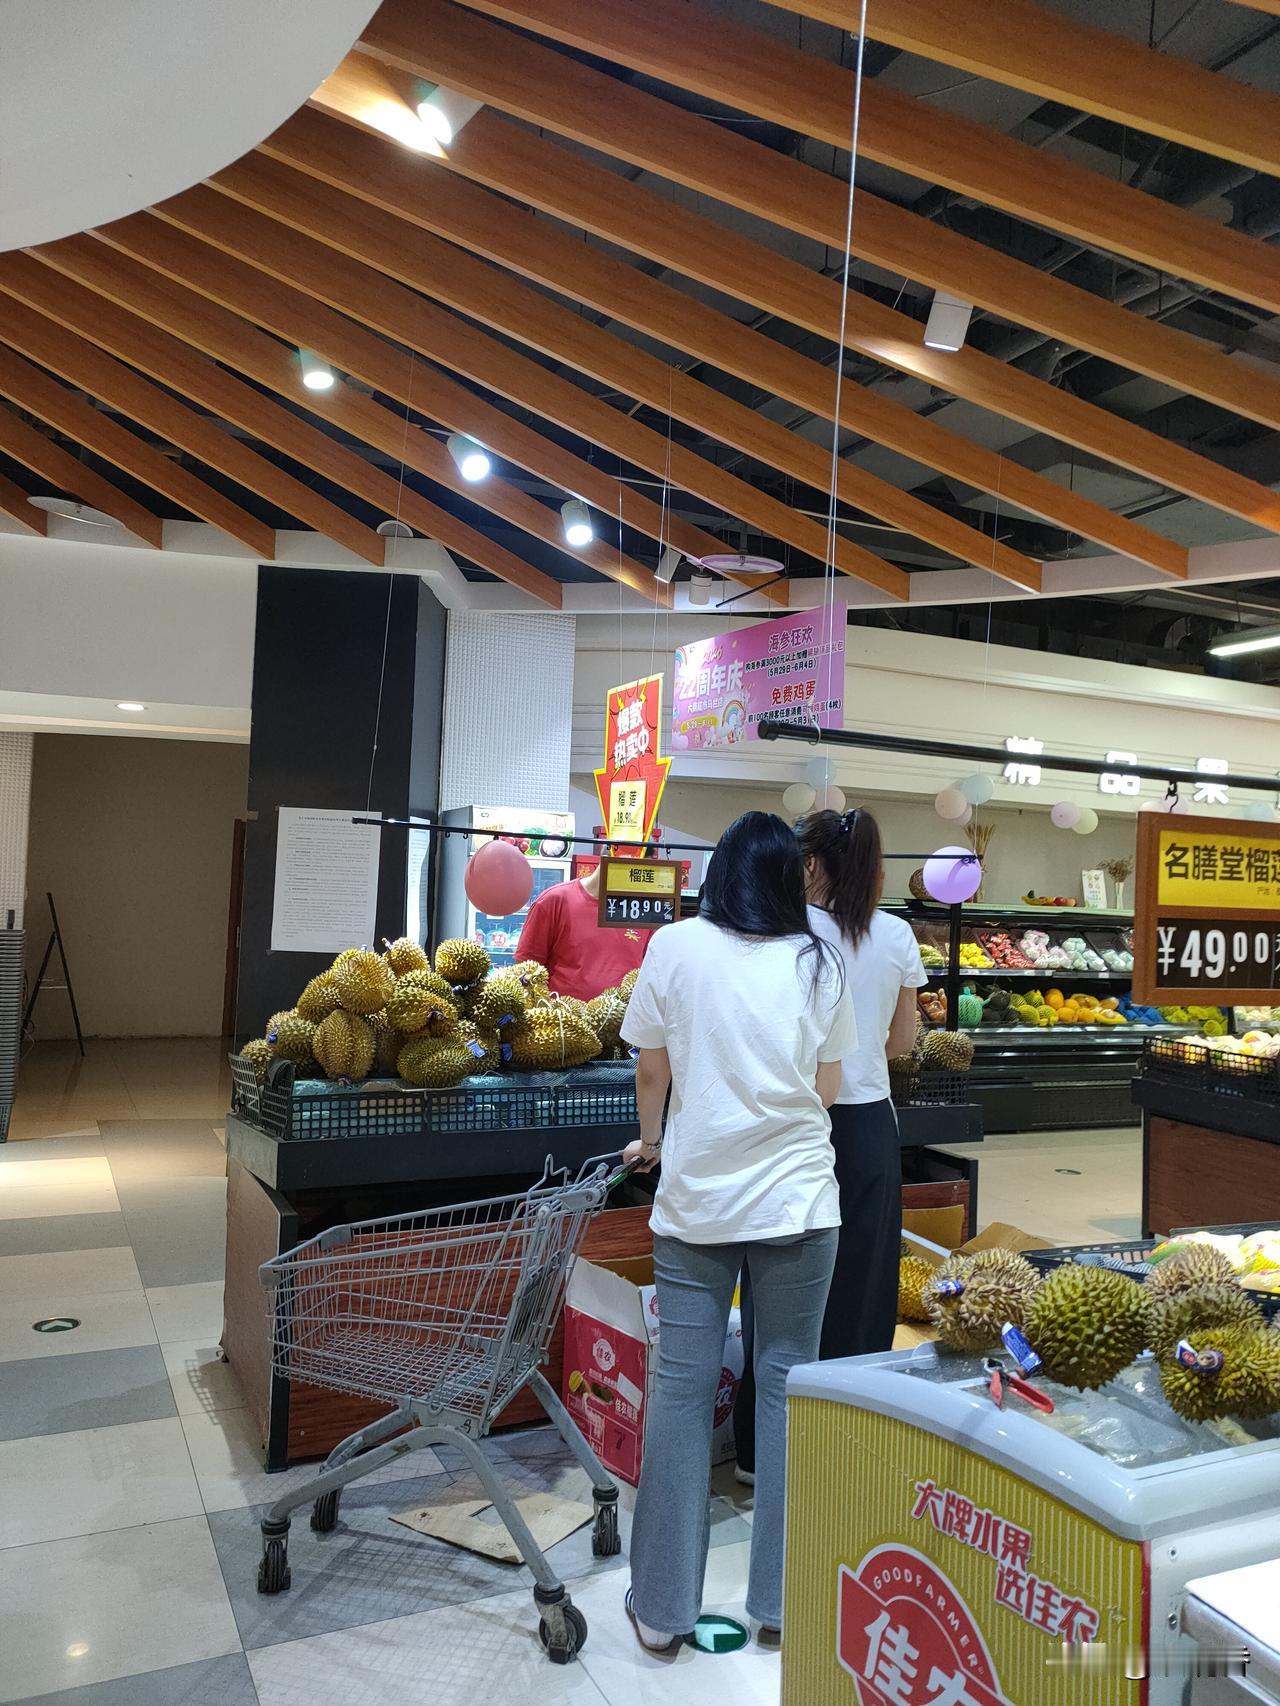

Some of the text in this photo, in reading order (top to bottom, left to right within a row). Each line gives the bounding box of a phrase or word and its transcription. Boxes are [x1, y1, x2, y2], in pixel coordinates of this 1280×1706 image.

[768, 624, 814, 652] 海参狂欢
[771, 680, 816, 706] 免费鸡蛋
[617, 699, 643, 737] 爆款
[614, 725, 649, 769] 热卖中
[630, 868, 655, 883] 榴莲
[1157, 927, 1269, 979] ¥49.00
[912, 1481, 1031, 1572] 大牌水果
[873, 1567, 978, 1667] GOODFARMER
[996, 1566, 1097, 1644] 选佳农
